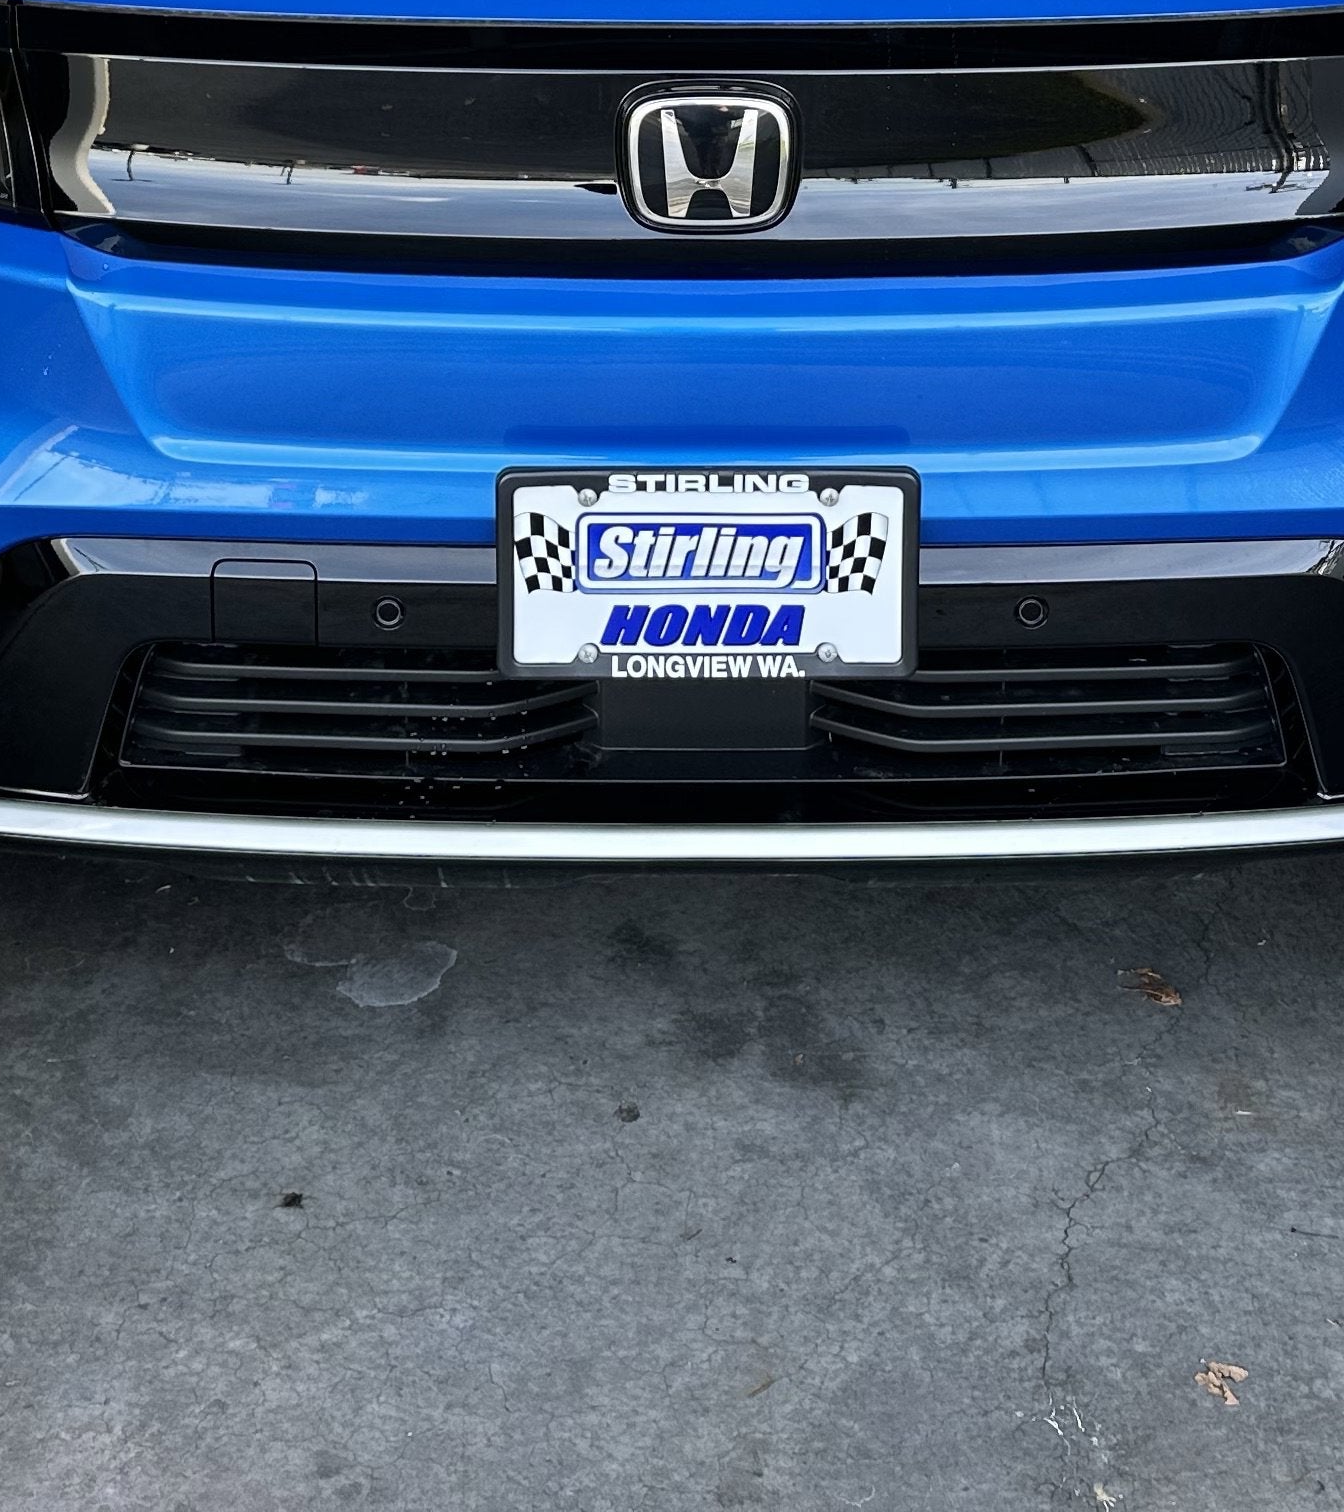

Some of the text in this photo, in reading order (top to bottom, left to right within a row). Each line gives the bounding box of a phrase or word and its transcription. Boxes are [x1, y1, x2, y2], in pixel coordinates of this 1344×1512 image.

[608, 474, 810, 493] STIRLING
[593, 526, 805, 587] Stirling
[600, 604, 806, 647] HONDA
[611, 654, 806, 678] LONGVIEW WA.
